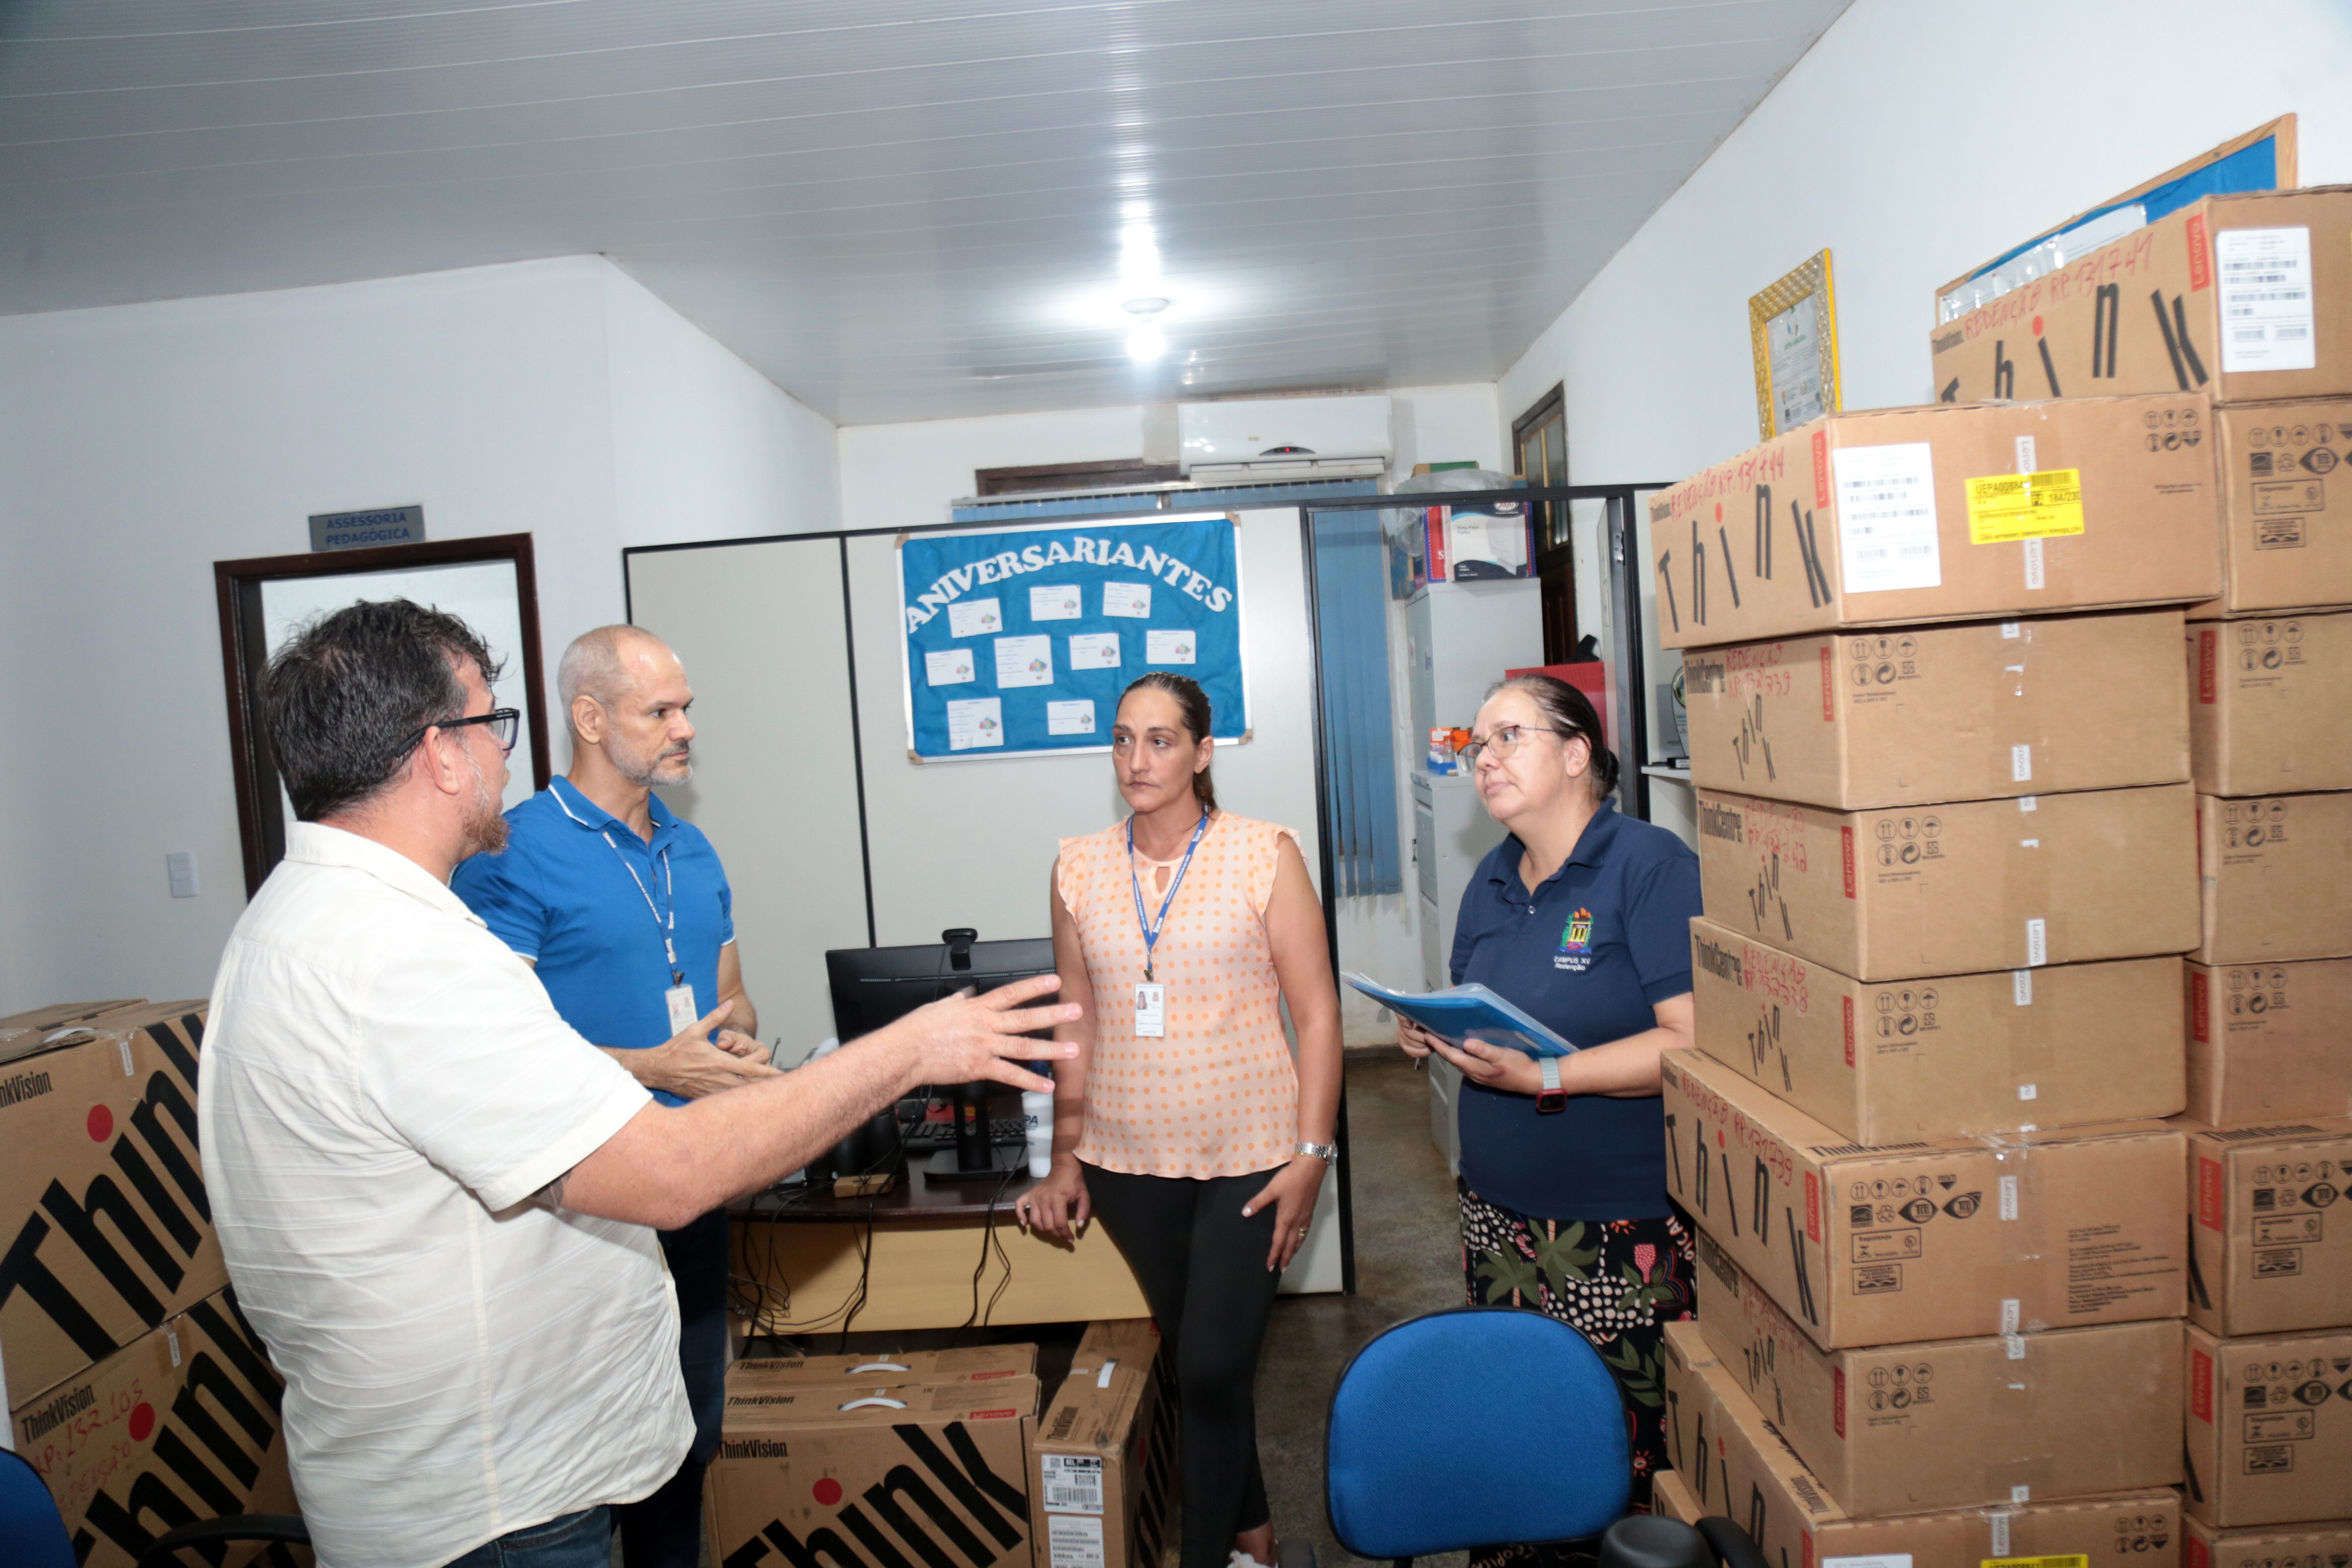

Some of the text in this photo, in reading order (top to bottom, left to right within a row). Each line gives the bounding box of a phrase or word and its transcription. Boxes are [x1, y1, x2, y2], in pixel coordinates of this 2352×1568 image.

[1815, 439, 1826, 505] Lenovo
[326, 528, 410, 545] PEDAGÓGICA
[327, 512, 406, 530] ASSESSORIA
[906, 536, 1233, 633] ANIVERSARIANTES
[1658, 485, 1832, 633] Think
[2202, 636, 2212, 699] Lenovo
[1844, 834, 1853, 893] Lenovo
[2033, 923, 2042, 963] Lenovo
[1845, 1004, 1854, 1065] Lenovo
[1666, 1113, 1820, 1327] Think
[1808, 1178, 1817, 1238] Lenovo
[2203, 1164, 2213, 1222] Lenovo
[739, 1359, 804, 1370] ThinkVision
[21, 1384, 97, 1445] ThinkVision
[728, 1394, 795, 1407] ThinkVision
[973, 1410, 1012, 1419] Lenovo
[1836, 1375, 1844, 1432] Lenovo
[719, 1439, 788, 1460] ThinkVision
